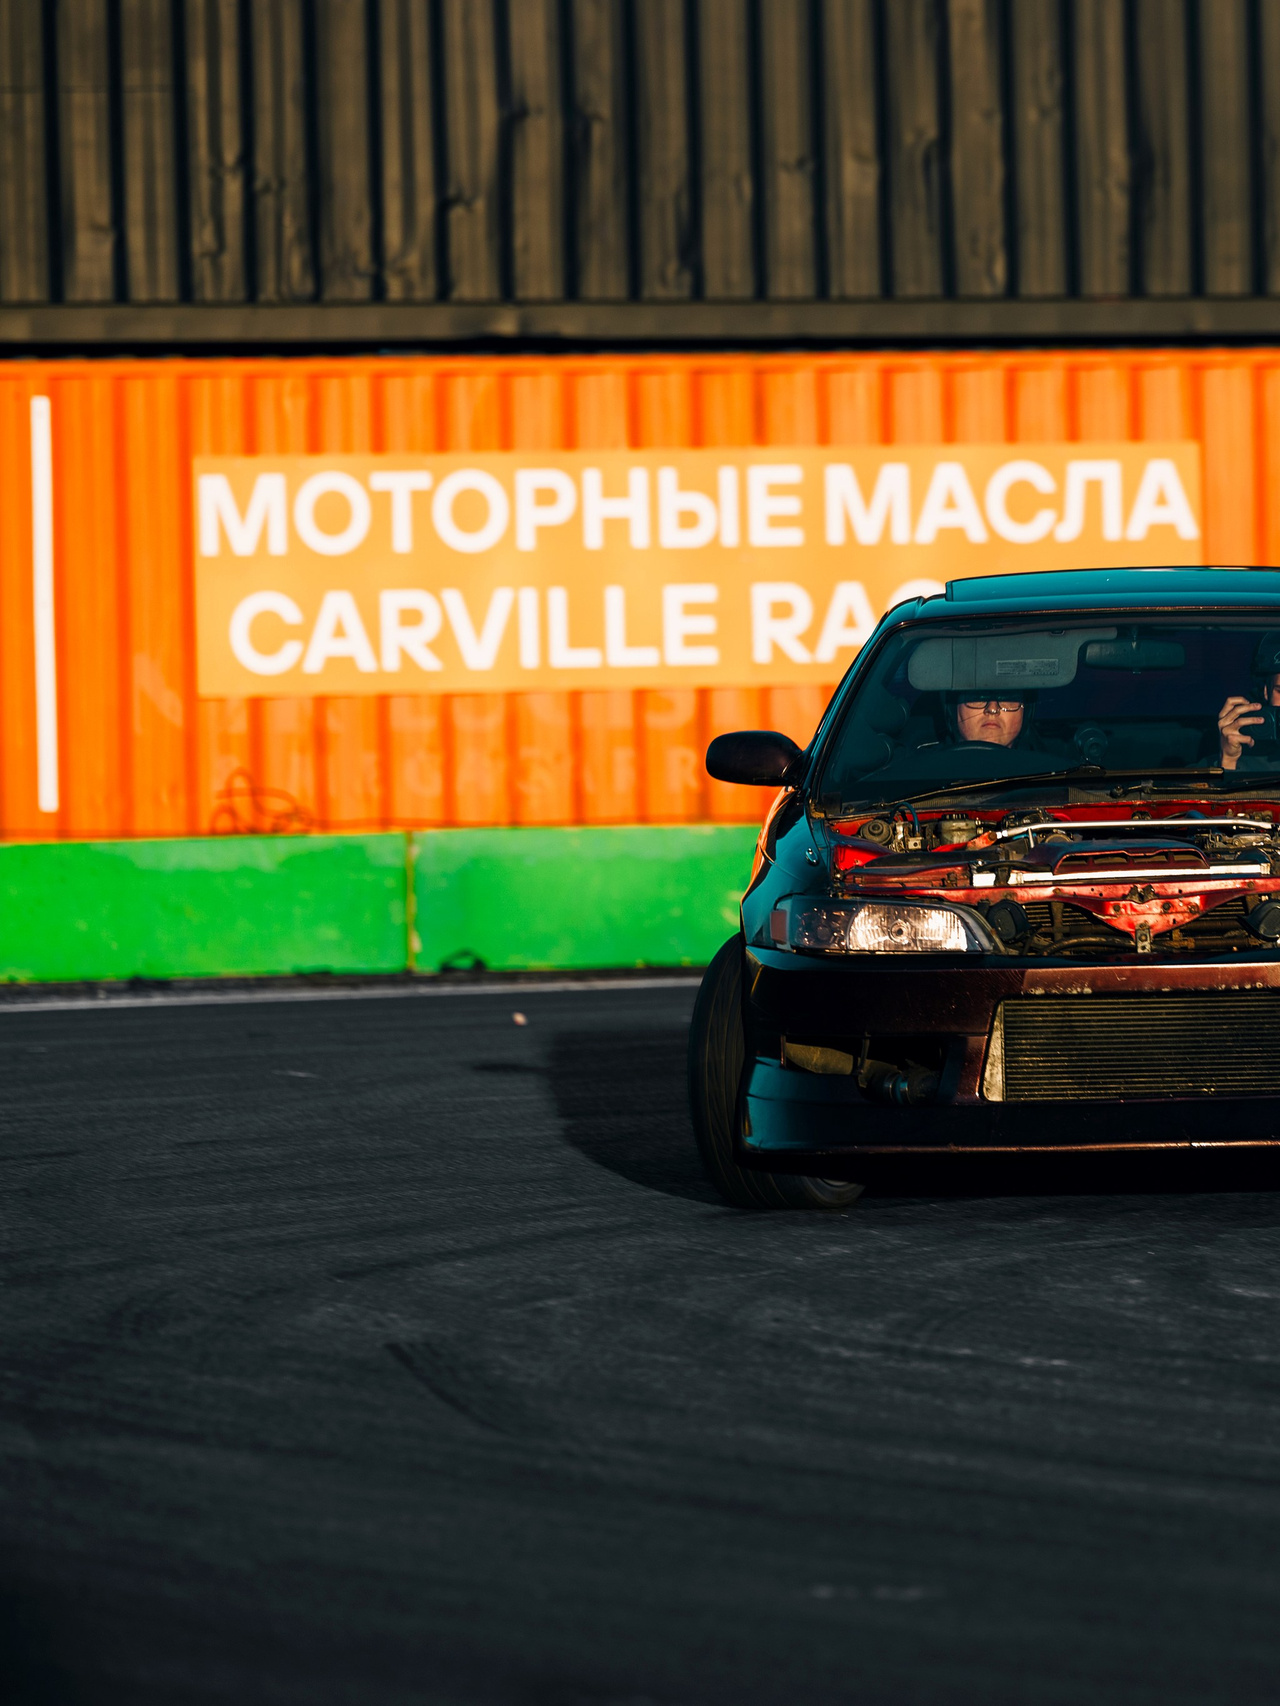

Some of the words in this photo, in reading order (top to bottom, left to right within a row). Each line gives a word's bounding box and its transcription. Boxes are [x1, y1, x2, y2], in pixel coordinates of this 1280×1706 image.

[198, 465, 804, 557] МОТОРНЫЕ
[825, 458, 1199, 545] МАСЛА
[228, 585, 720, 676] CARVILLE
